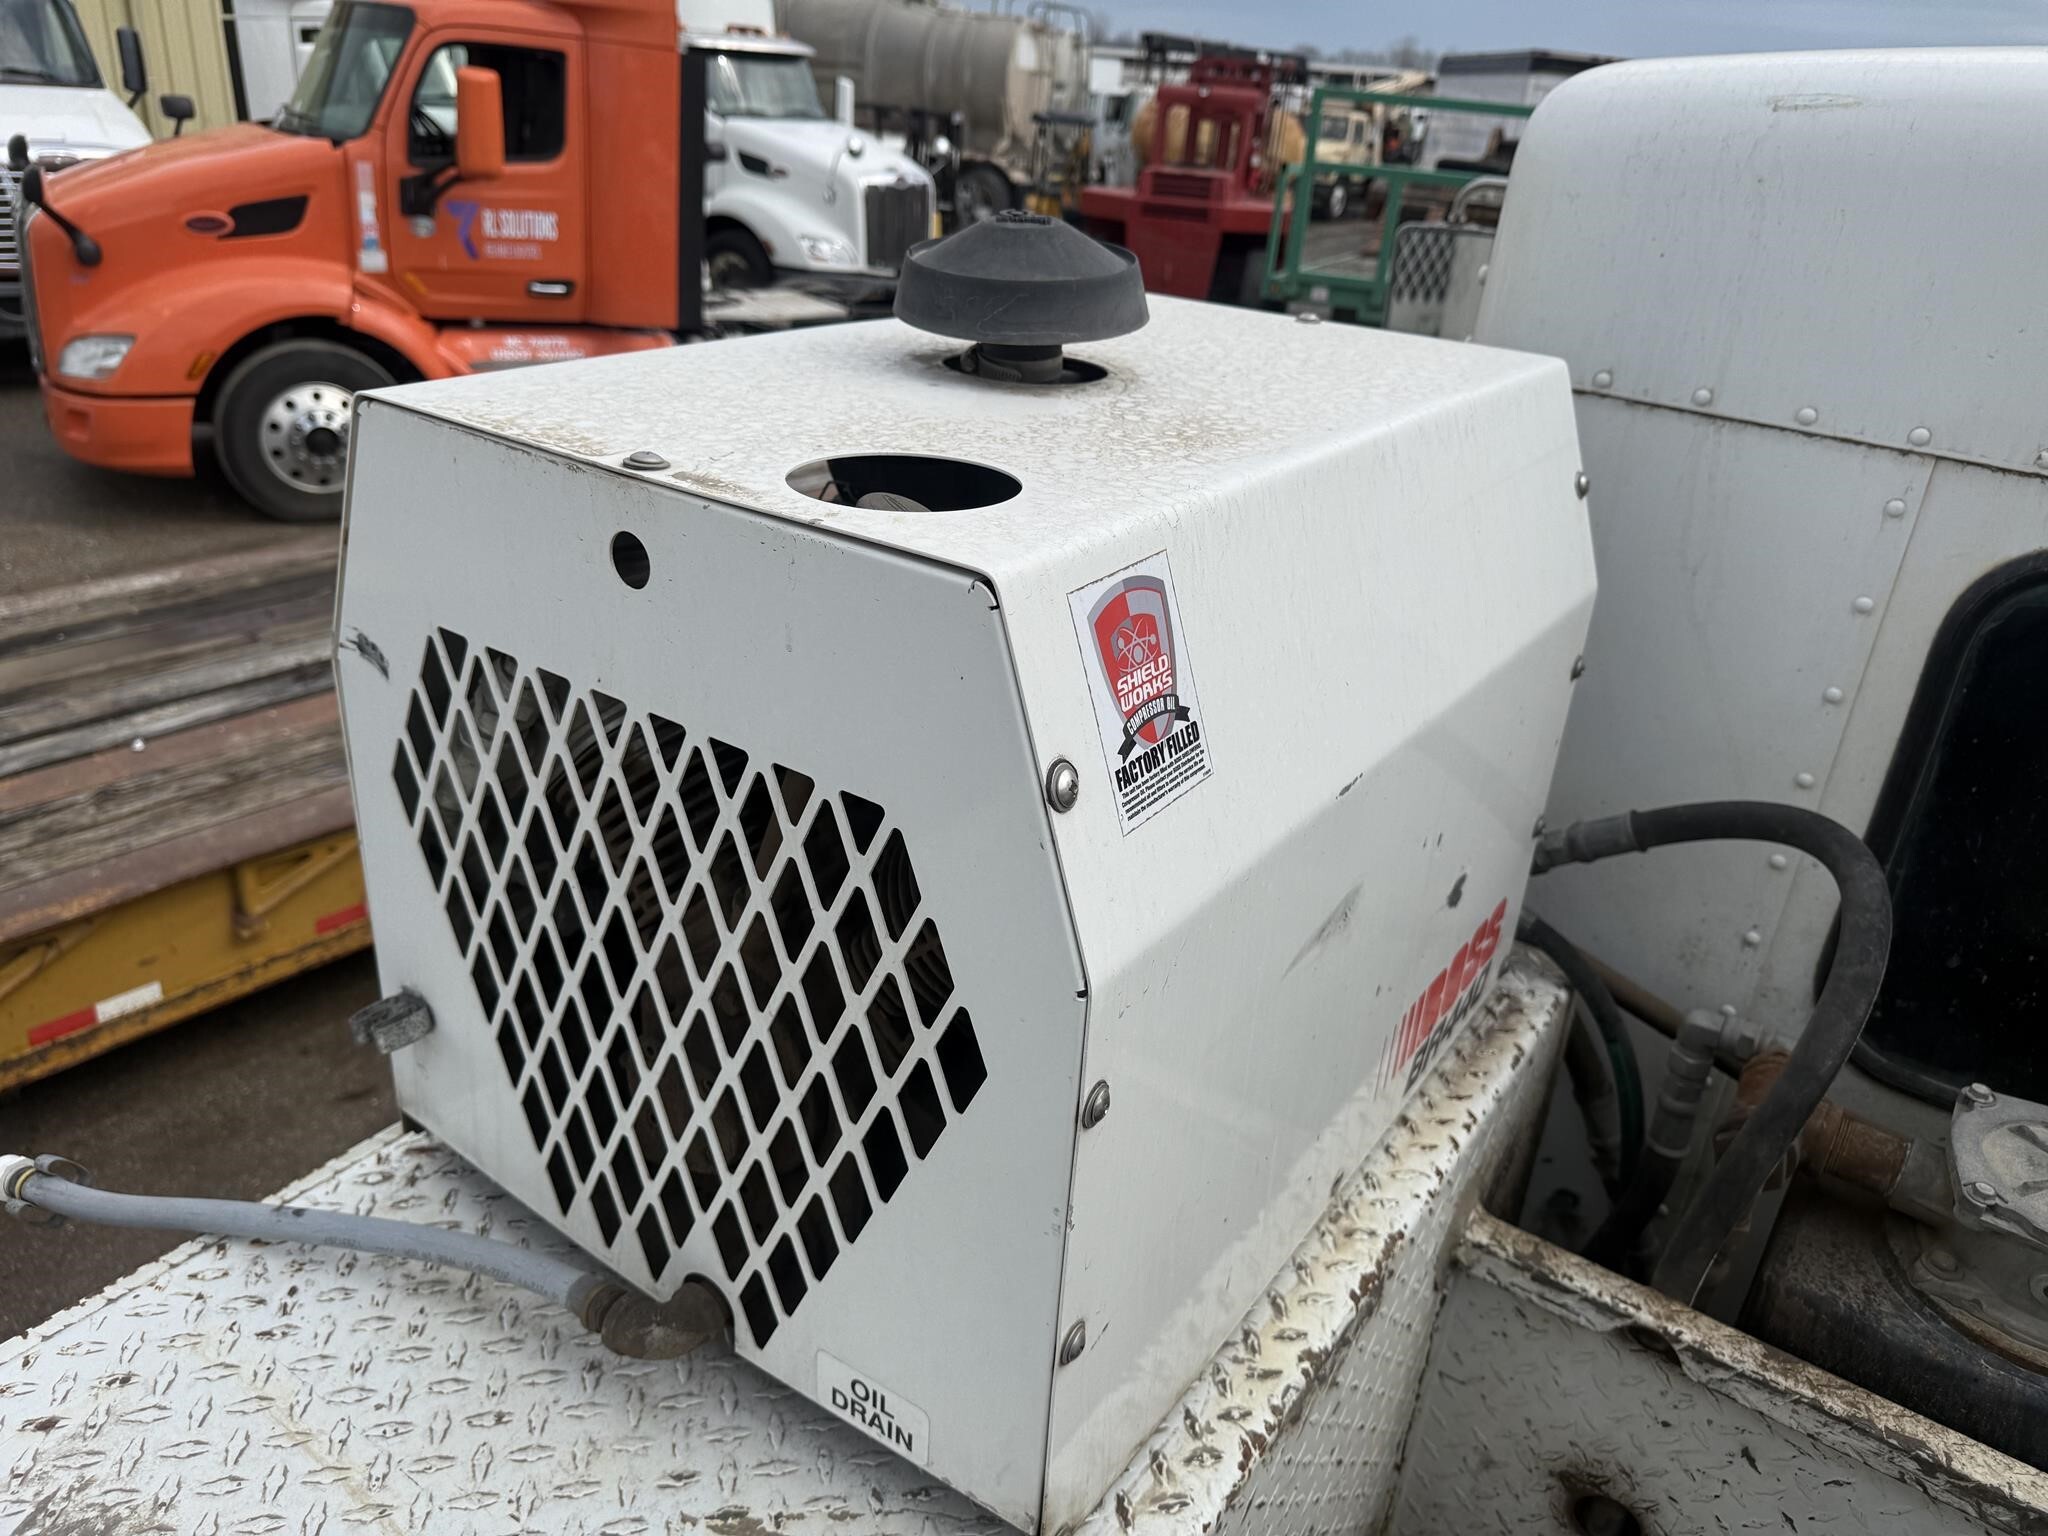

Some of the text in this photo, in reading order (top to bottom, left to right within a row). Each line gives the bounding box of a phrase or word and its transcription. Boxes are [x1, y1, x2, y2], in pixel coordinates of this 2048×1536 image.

[498, 209, 559, 241] SOLUTIONS
[1116, 655, 1169, 696] SHIELD
[1120, 670, 1173, 712] WORKS
[1127, 697, 1175, 734] COMPRESSOR OIL
[1115, 720, 1200, 792] FACTORY FILLED
[1149, 771, 1159, 781] factory
[1184, 764, 1193, 773] service
[1122, 792, 1139, 808] Compressor
[1145, 782, 1154, 792] Please
[1155, 775, 1165, 785] contact
[1411, 896, 1508, 1053] BOSS
[851, 1378, 894, 1419] OIL
[832, 1387, 913, 1452] DRAIN
